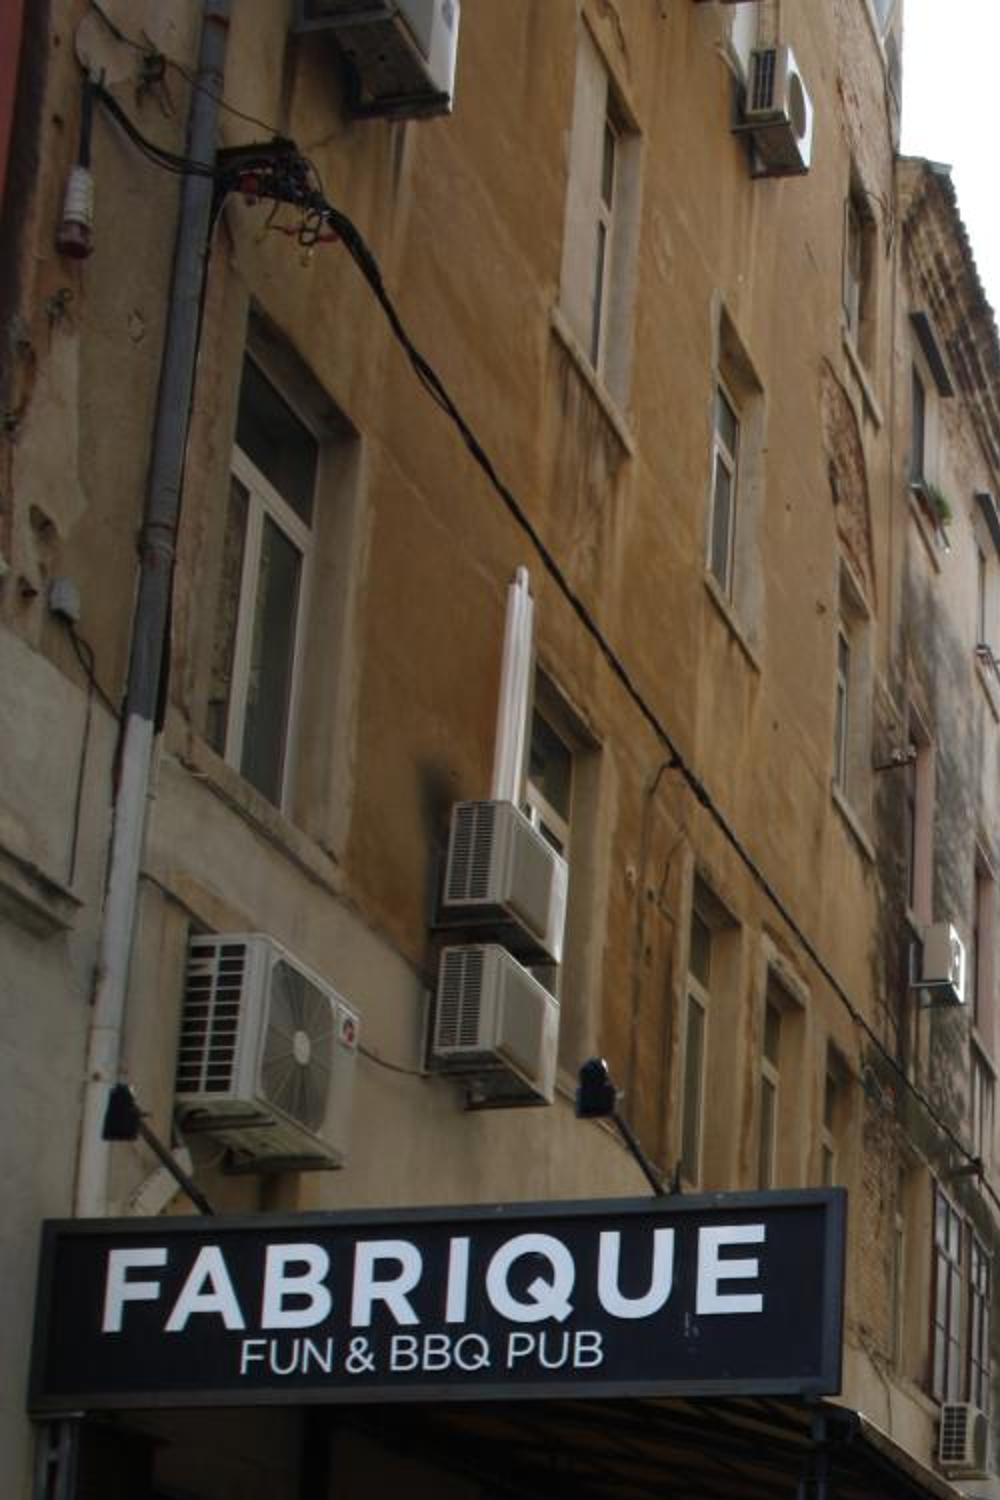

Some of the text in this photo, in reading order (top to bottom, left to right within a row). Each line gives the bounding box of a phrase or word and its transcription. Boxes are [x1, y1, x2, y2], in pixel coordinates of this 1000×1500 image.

[101, 1223, 767, 1333] FABRIQUE
[239, 1330, 604, 1376] FUN & BBQ PUB
